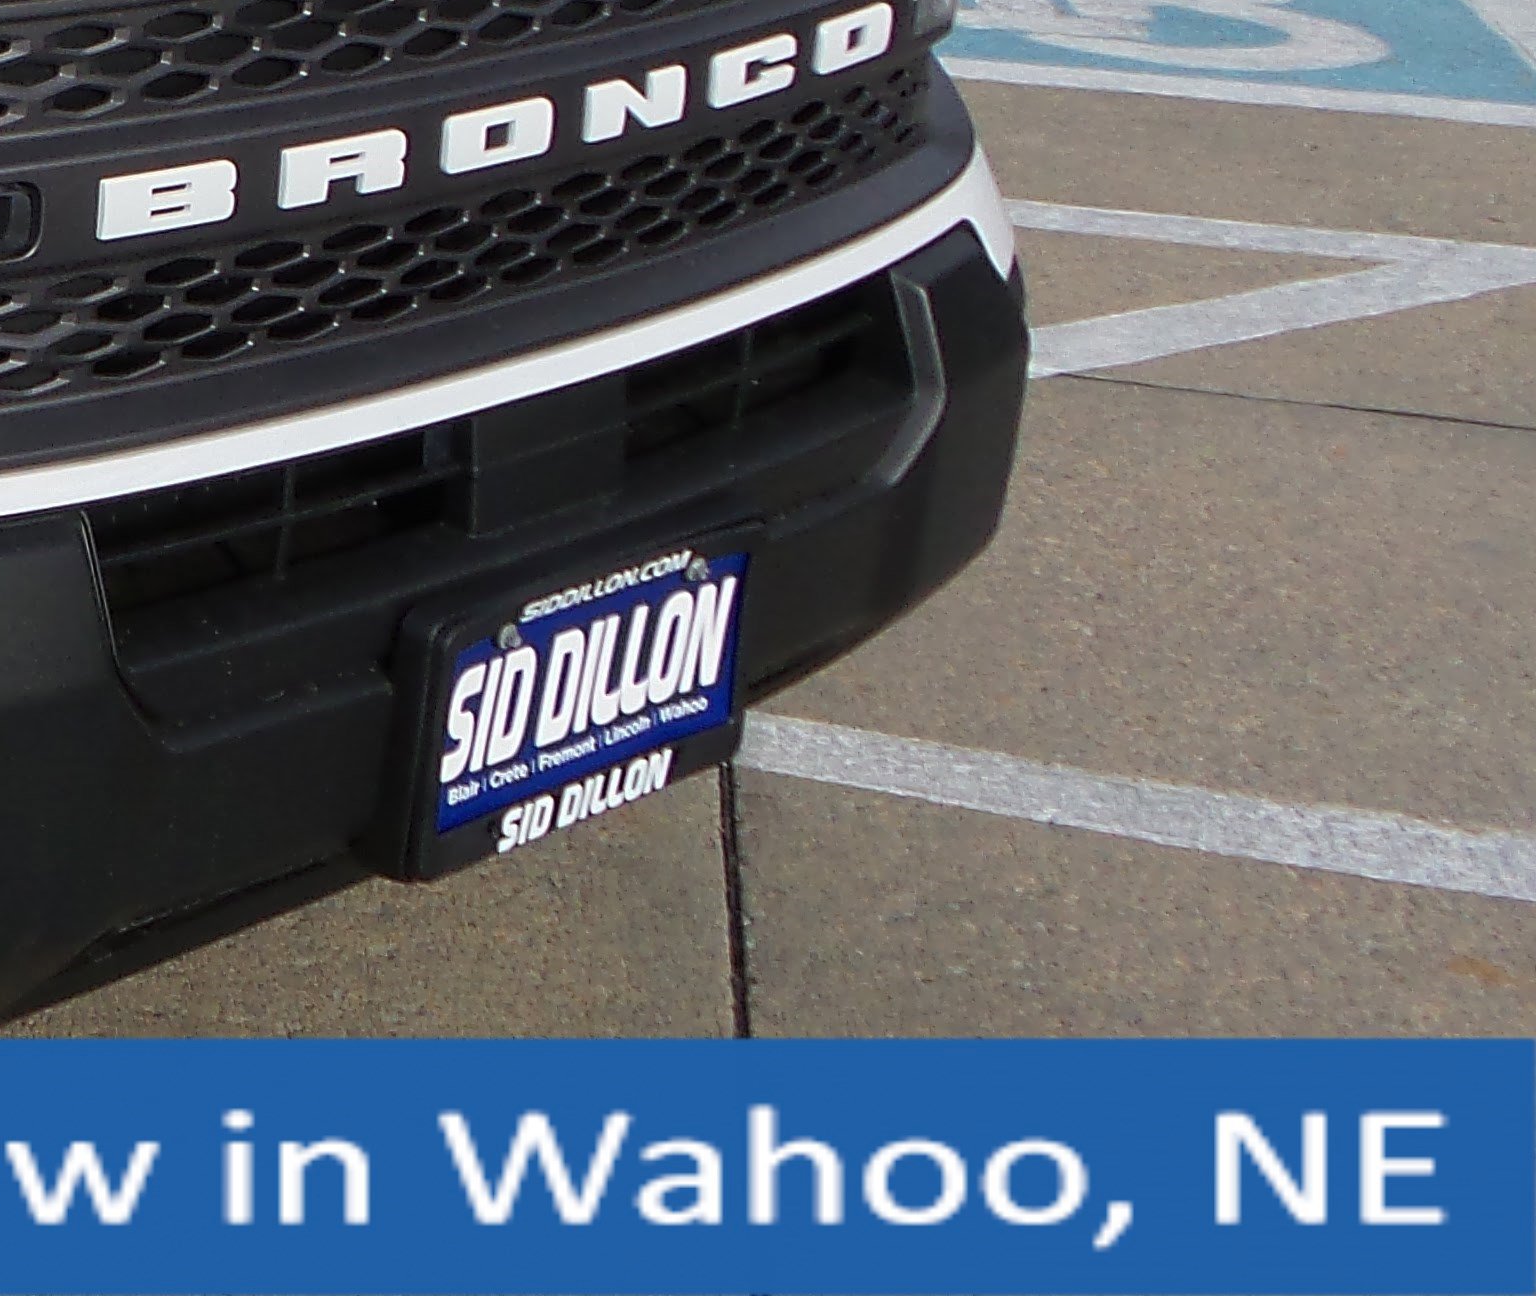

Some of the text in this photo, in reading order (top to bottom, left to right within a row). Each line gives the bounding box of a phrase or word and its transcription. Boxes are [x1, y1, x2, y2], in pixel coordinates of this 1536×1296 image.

[95, 1, 895, 242] BRONCO
[440, 576, 738, 784] SID DILLON
[447, 696, 709, 806] Blair Crete Fremont Lincoln Wahoo
[496, 748, 675, 854] SID DILLON
